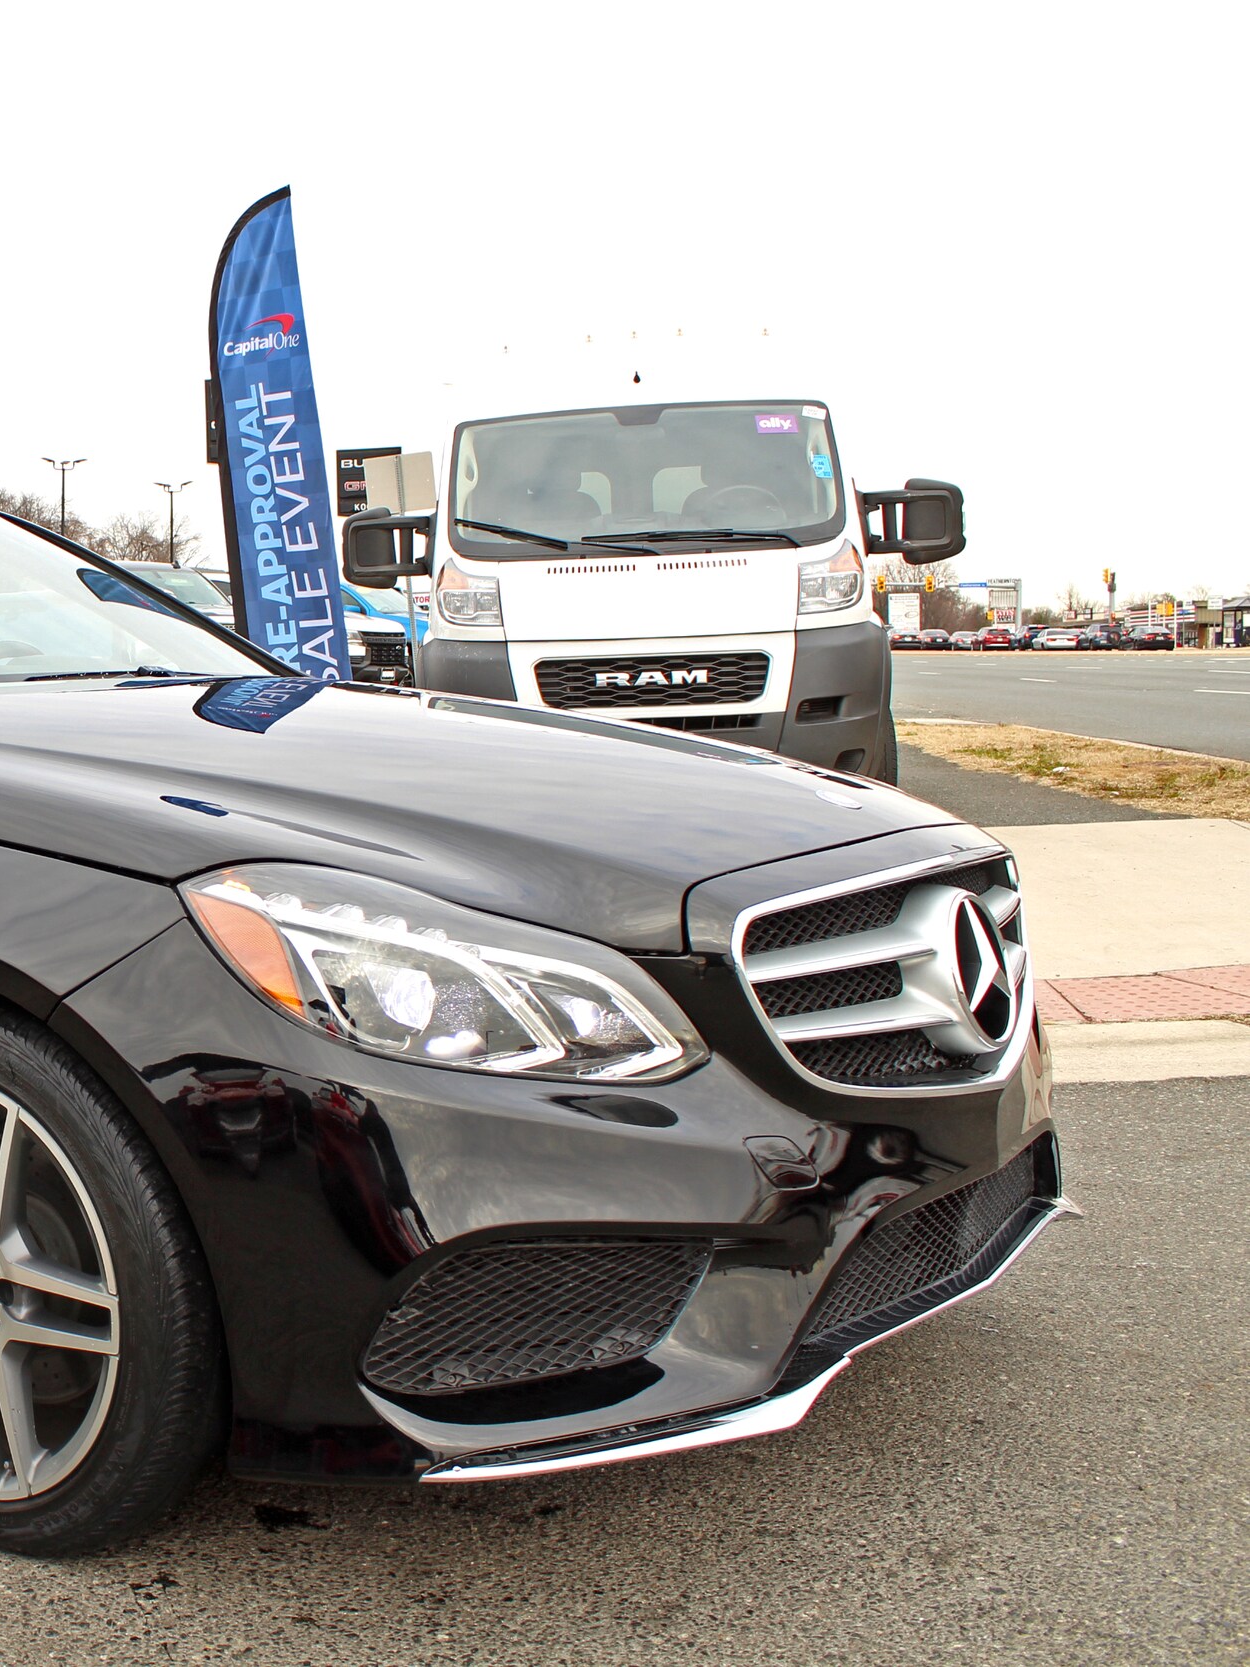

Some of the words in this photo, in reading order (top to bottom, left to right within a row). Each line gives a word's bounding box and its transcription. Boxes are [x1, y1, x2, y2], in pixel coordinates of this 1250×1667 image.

[235, 384, 311, 676] RE-APPROVAL
[258, 382, 319, 552] EVENT
[595, 670, 708, 687] RAM
